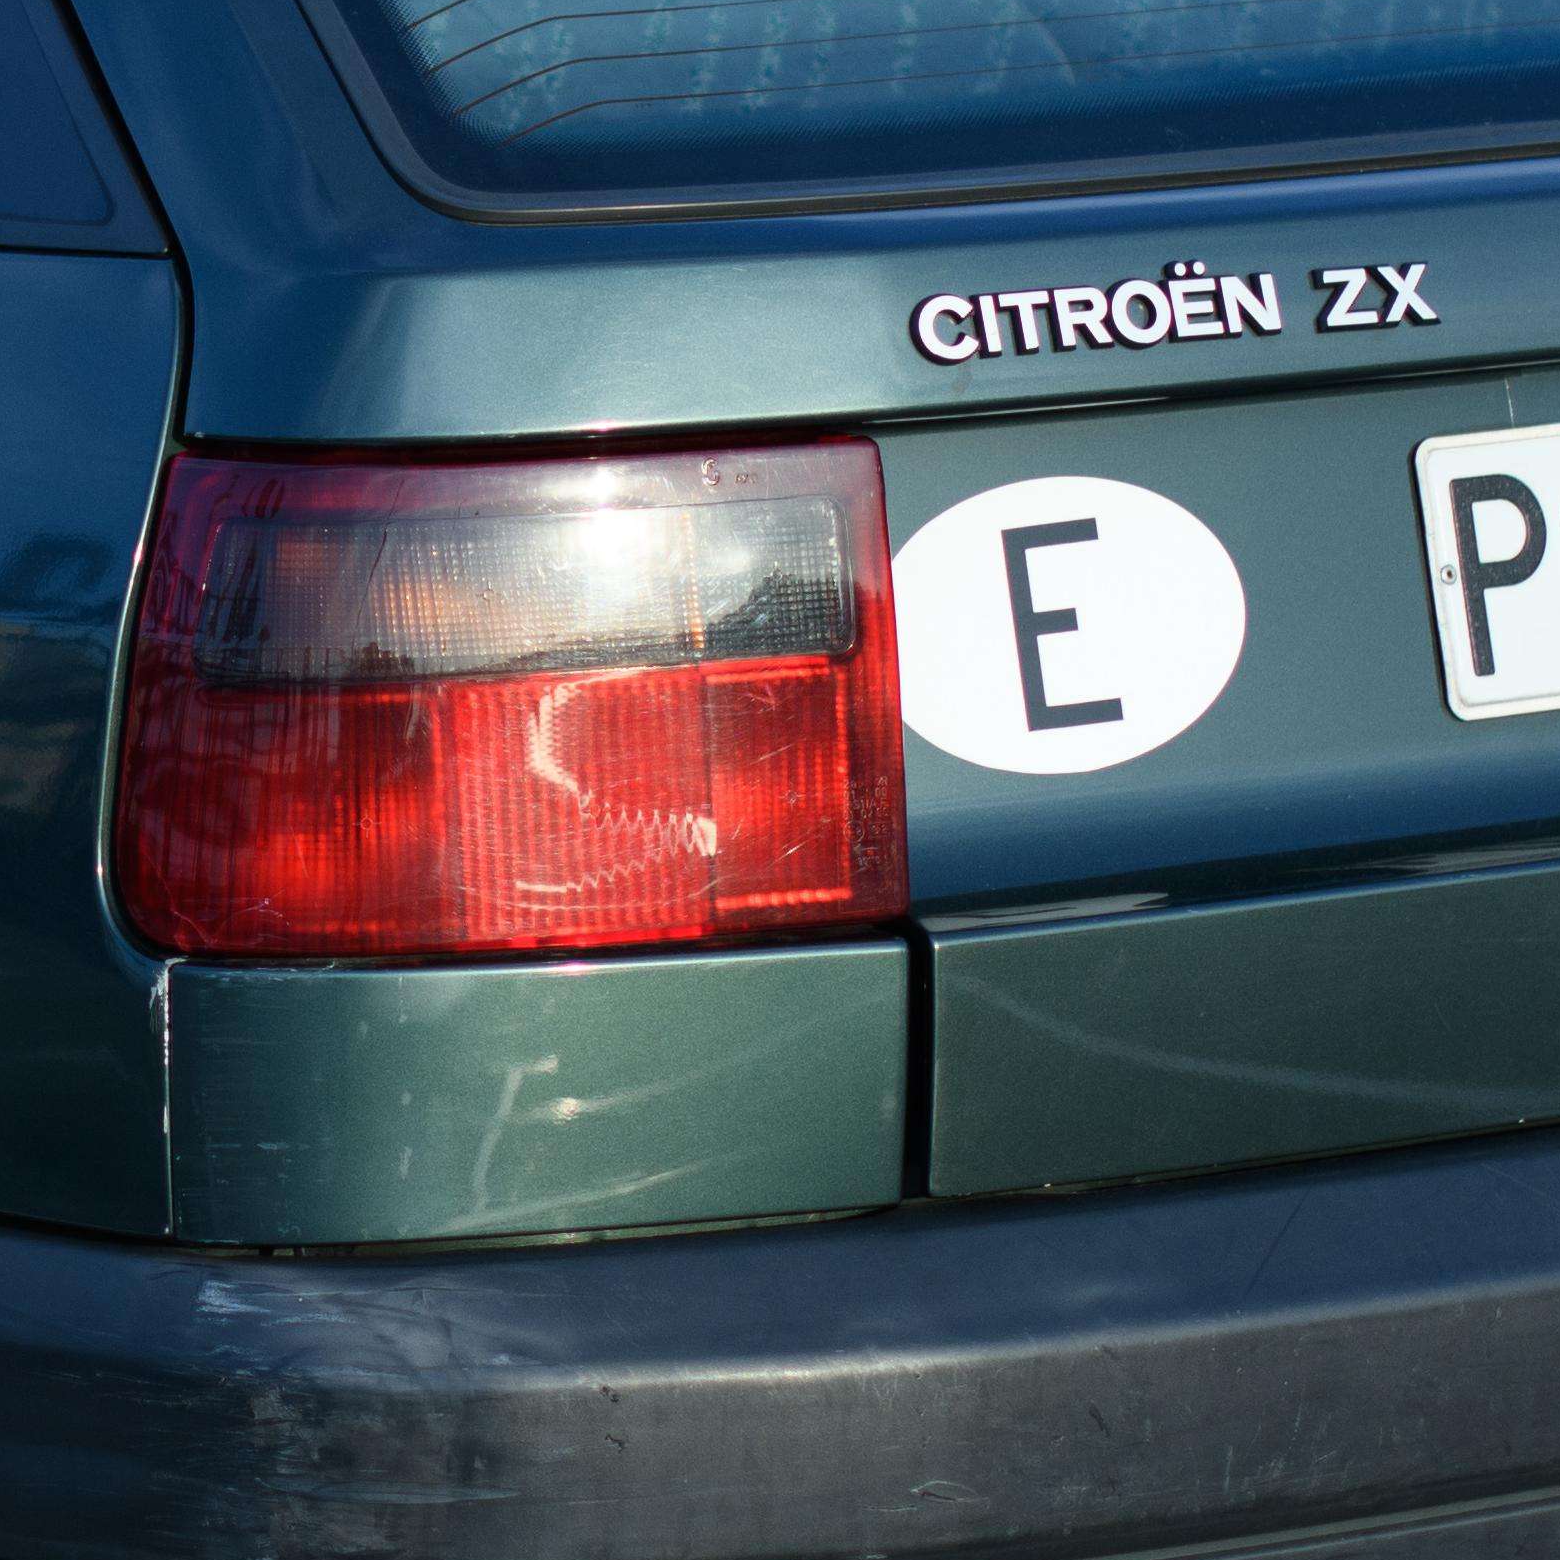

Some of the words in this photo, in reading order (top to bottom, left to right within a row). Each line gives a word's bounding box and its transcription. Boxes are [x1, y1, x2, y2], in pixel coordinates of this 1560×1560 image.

[914, 261, 1281, 364] CITROËN
[1314, 262, 1440, 331] ZX
[1000, 516, 1124, 733] E
